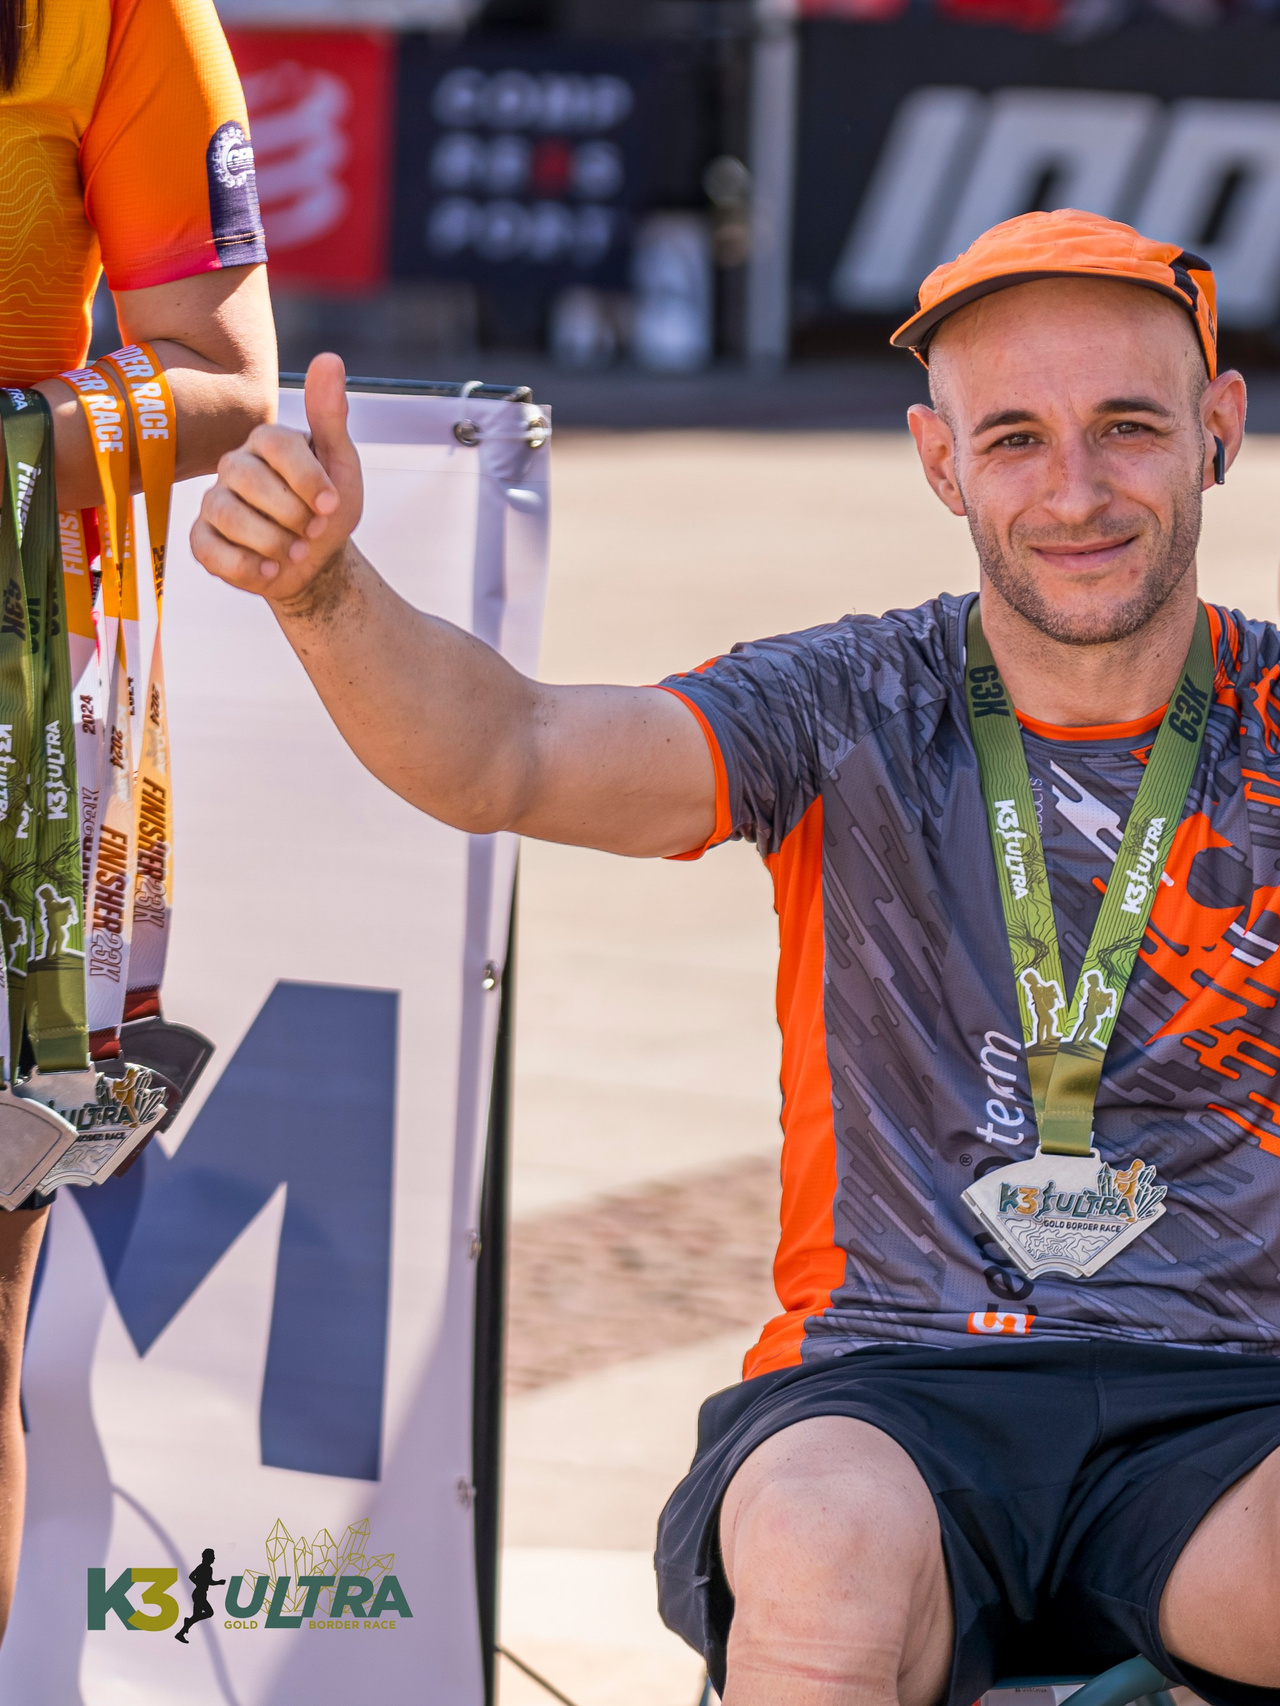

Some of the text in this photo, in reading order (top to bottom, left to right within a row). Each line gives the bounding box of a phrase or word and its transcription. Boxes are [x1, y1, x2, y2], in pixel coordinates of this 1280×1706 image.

[85, 393, 123, 453] RACE
[130, 382, 169, 440] RACE
[59, 508, 84, 575] FINIS
[80, 694, 96, 736] 2024
[968, 664, 1011, 718] 63K
[1168, 673, 1209, 743] 63K
[45, 720, 68, 820] K3 ULTRA
[110, 725, 124, 769] 2024
[134, 777, 167, 930] FINISHER 23K
[994, 798, 1029, 901] K3 ULTRA
[1121, 817, 1166, 915] K3 ULTRA
[90, 824, 128, 983] FINISHER 23K
[1000, 1181, 1134, 1219] K3 ULTRA
[1044, 1219, 1122, 1233] GOLD BORDER RACE
